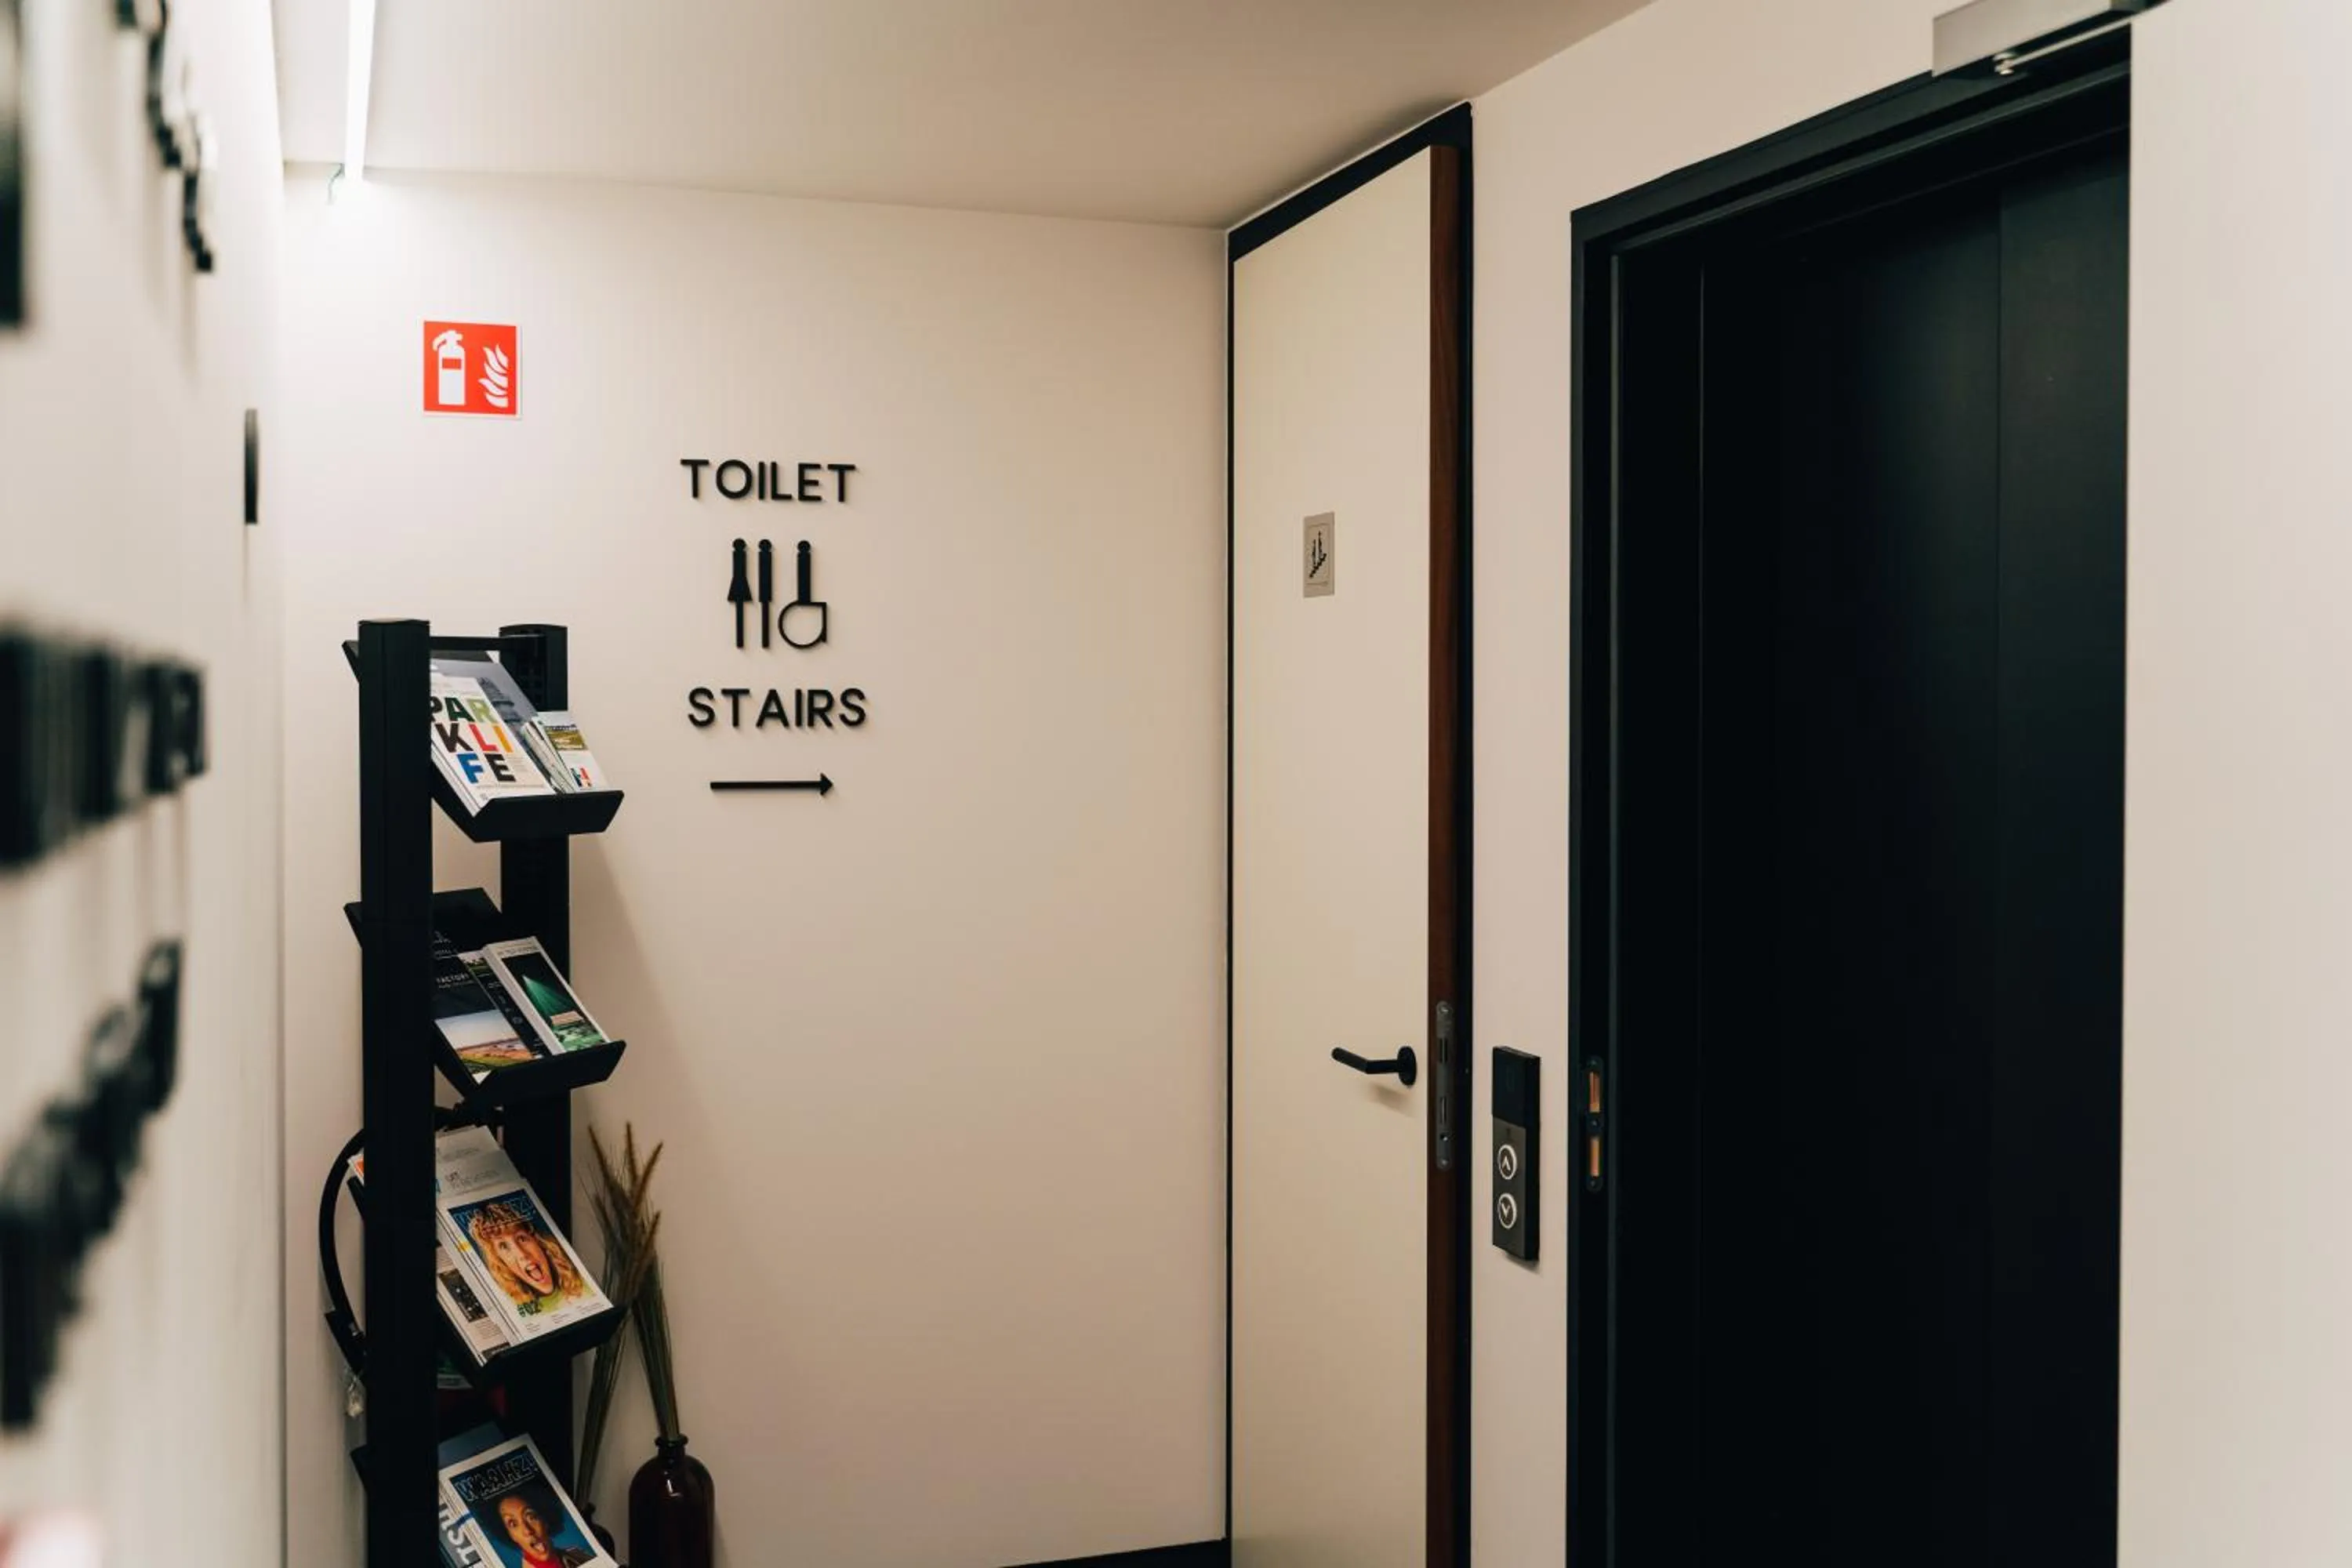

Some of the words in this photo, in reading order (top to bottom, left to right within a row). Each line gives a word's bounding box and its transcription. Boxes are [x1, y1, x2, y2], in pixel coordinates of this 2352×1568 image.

[681, 459, 855, 502] TOILET
[688, 687, 866, 728] STAIRS
[435, 723, 514, 753] KLI
[456, 753, 517, 783] FE
